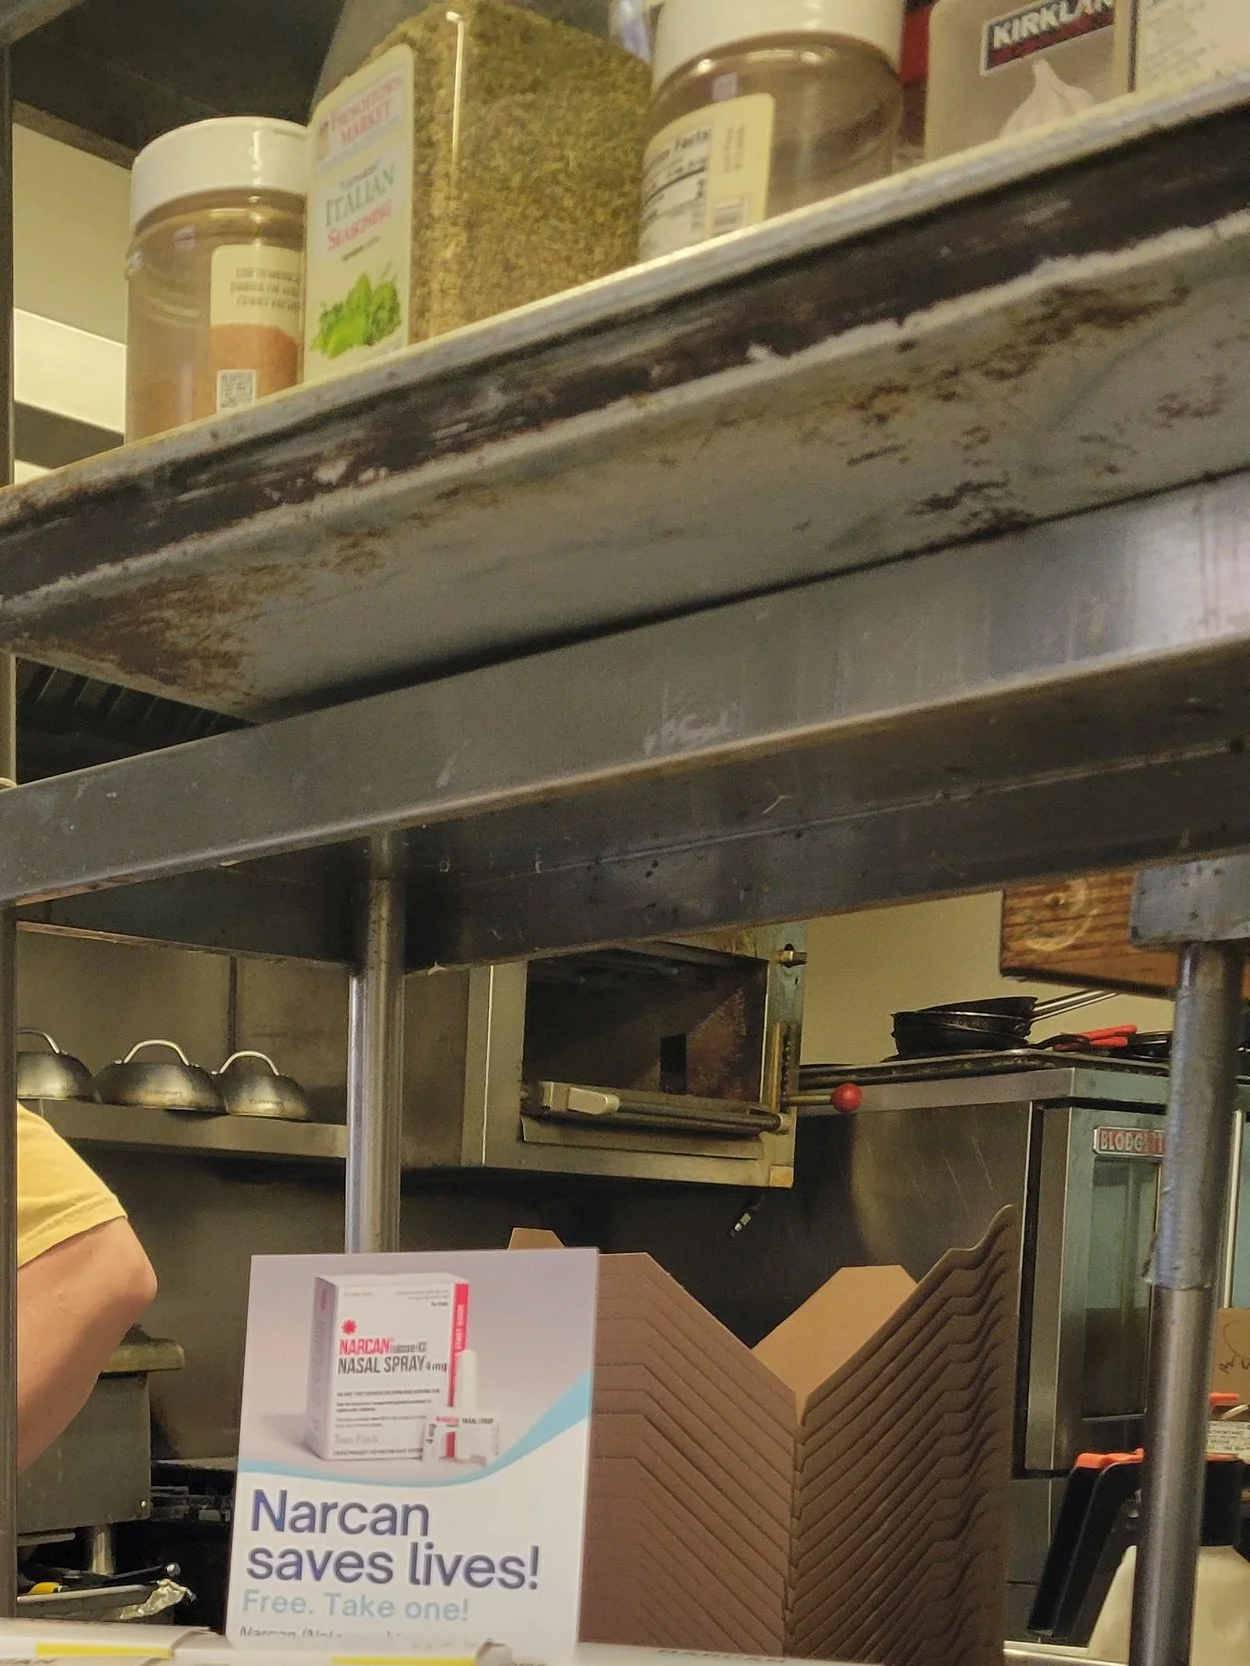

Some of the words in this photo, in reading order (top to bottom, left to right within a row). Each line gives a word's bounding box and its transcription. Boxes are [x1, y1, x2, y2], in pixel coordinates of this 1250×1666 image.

[994, 0, 1114, 48] KIRKLAN
[338, 1356, 380, 1374] NASAL
[384, 1355, 425, 1373] SPRAY
[432, 1362, 447, 1373] mg
[339, 1338, 392, 1355] NARCAN
[250, 1488, 430, 1537] Narcan
[246, 1546, 395, 1584] saves
[408, 1541, 540, 1591] lives!
[242, 1589, 315, 1615] Free.
[324, 1591, 395, 1619] Take
[404, 1598, 469, 1622] one!
